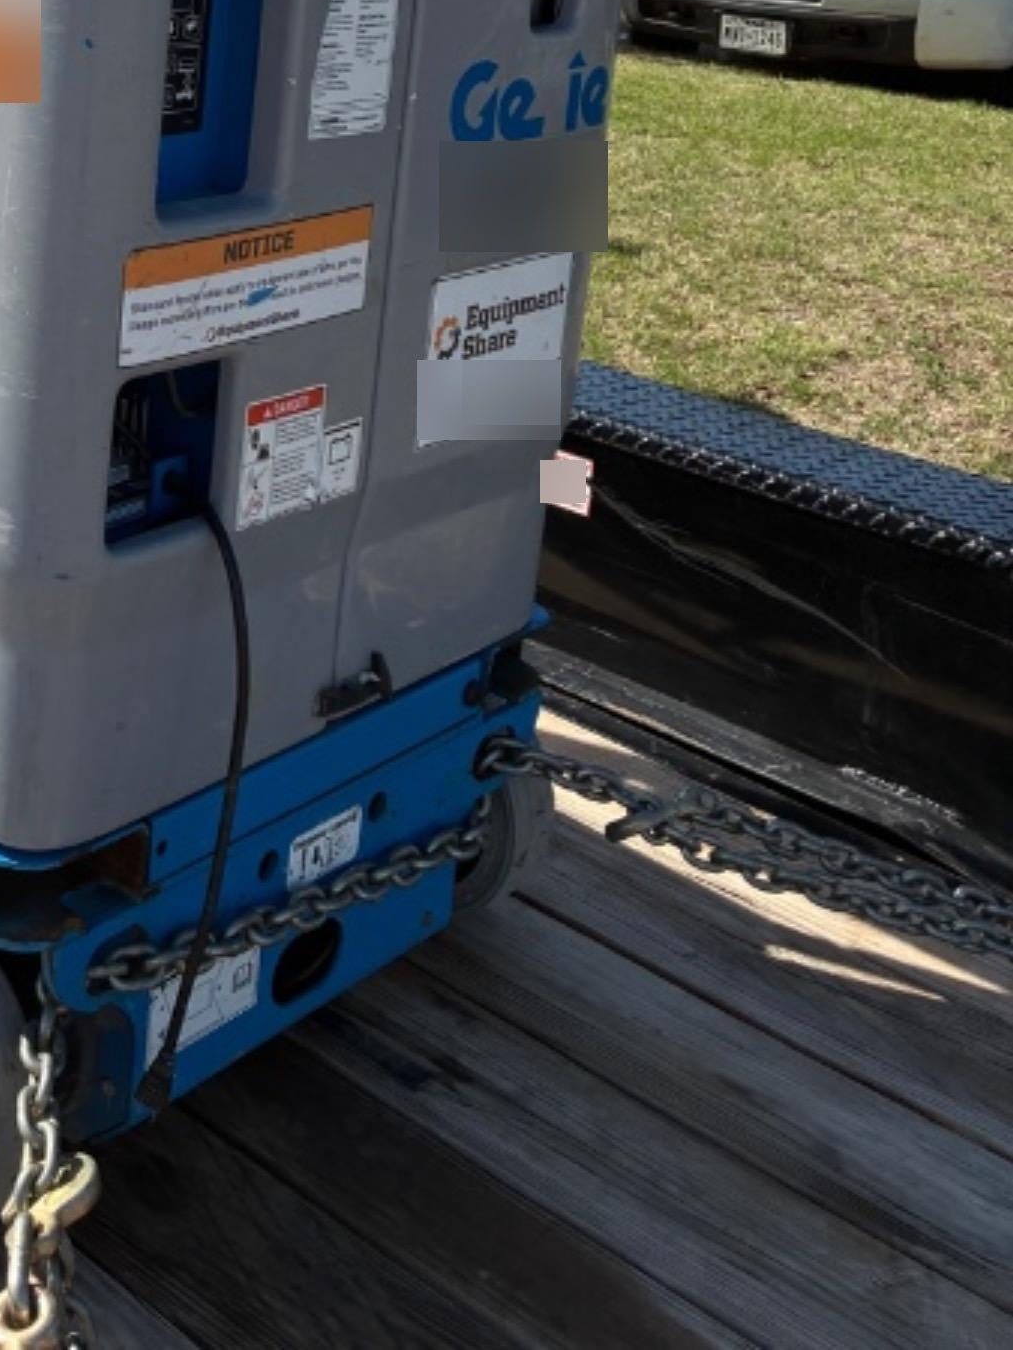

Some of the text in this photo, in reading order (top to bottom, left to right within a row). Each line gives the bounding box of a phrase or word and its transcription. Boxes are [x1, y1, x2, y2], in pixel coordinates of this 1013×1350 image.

[222, 229, 295, 265] NOTICE
[465, 282, 566, 331] Equipment
[461, 329, 518, 360] Share
